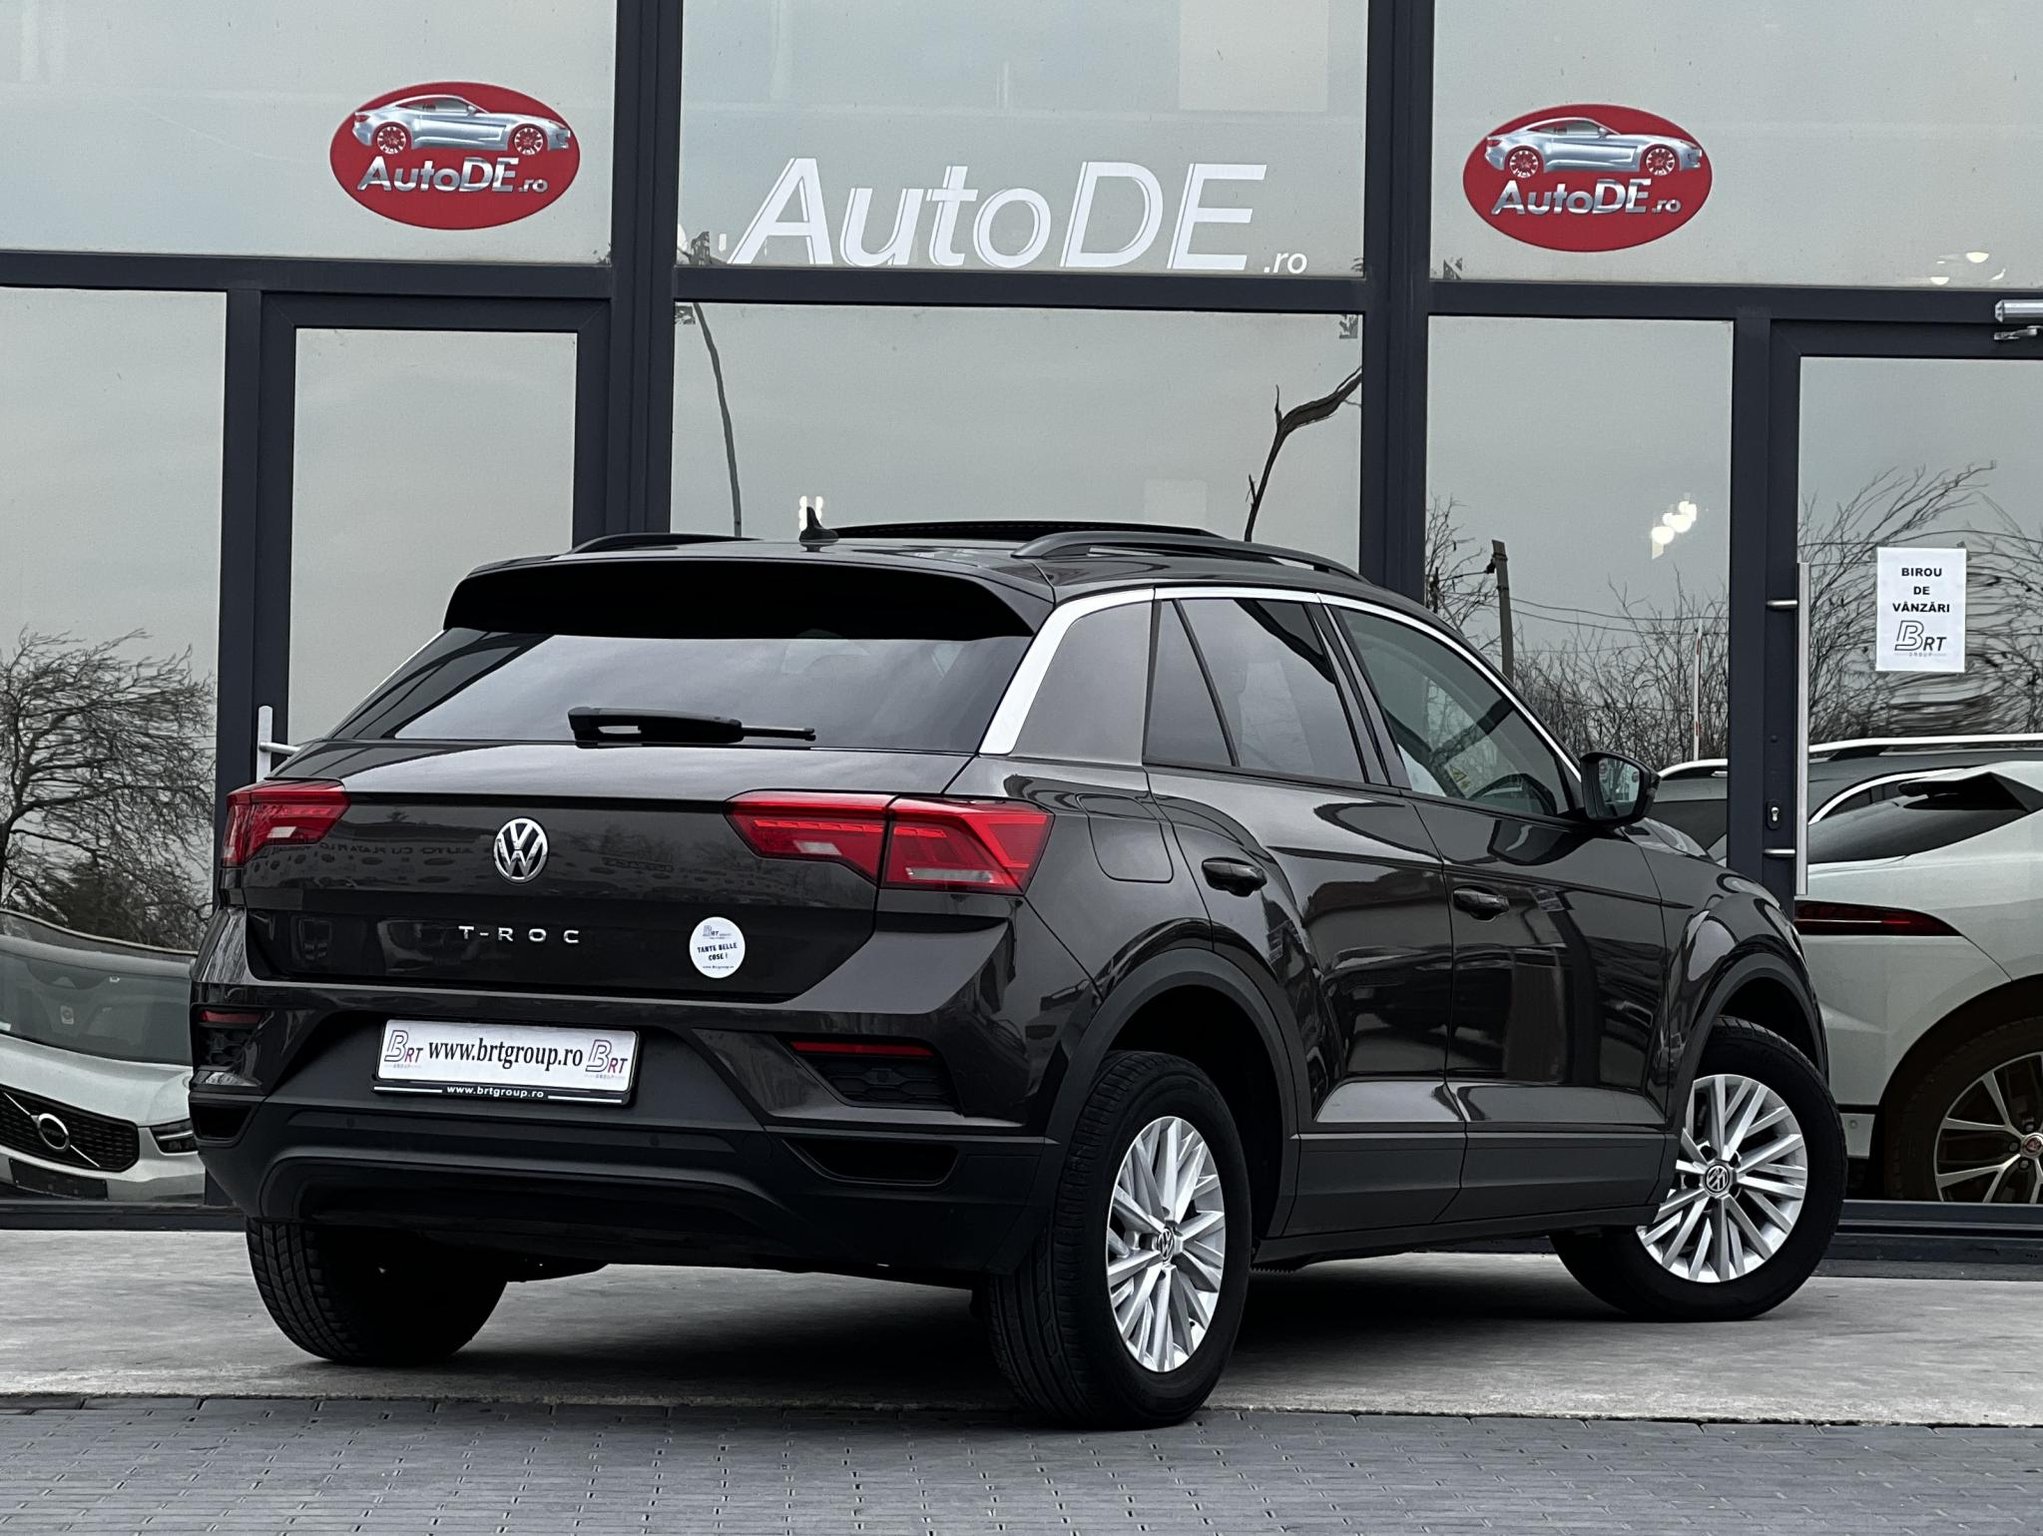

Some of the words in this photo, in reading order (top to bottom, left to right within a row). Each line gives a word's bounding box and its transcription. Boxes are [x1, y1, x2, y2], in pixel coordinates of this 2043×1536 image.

[1901, 567, 1943, 577] BIROU
[1913, 586, 1930, 595] DE
[1892, 602, 1950, 613] VÂNZĂRI
[1894, 620, 1947, 652] BRT
[458, 926, 580, 944] T-ROC
[428, 1037, 583, 1071] www.brtgroup.ro
[446, 1085, 544, 1098] www.brtgroup.ro
